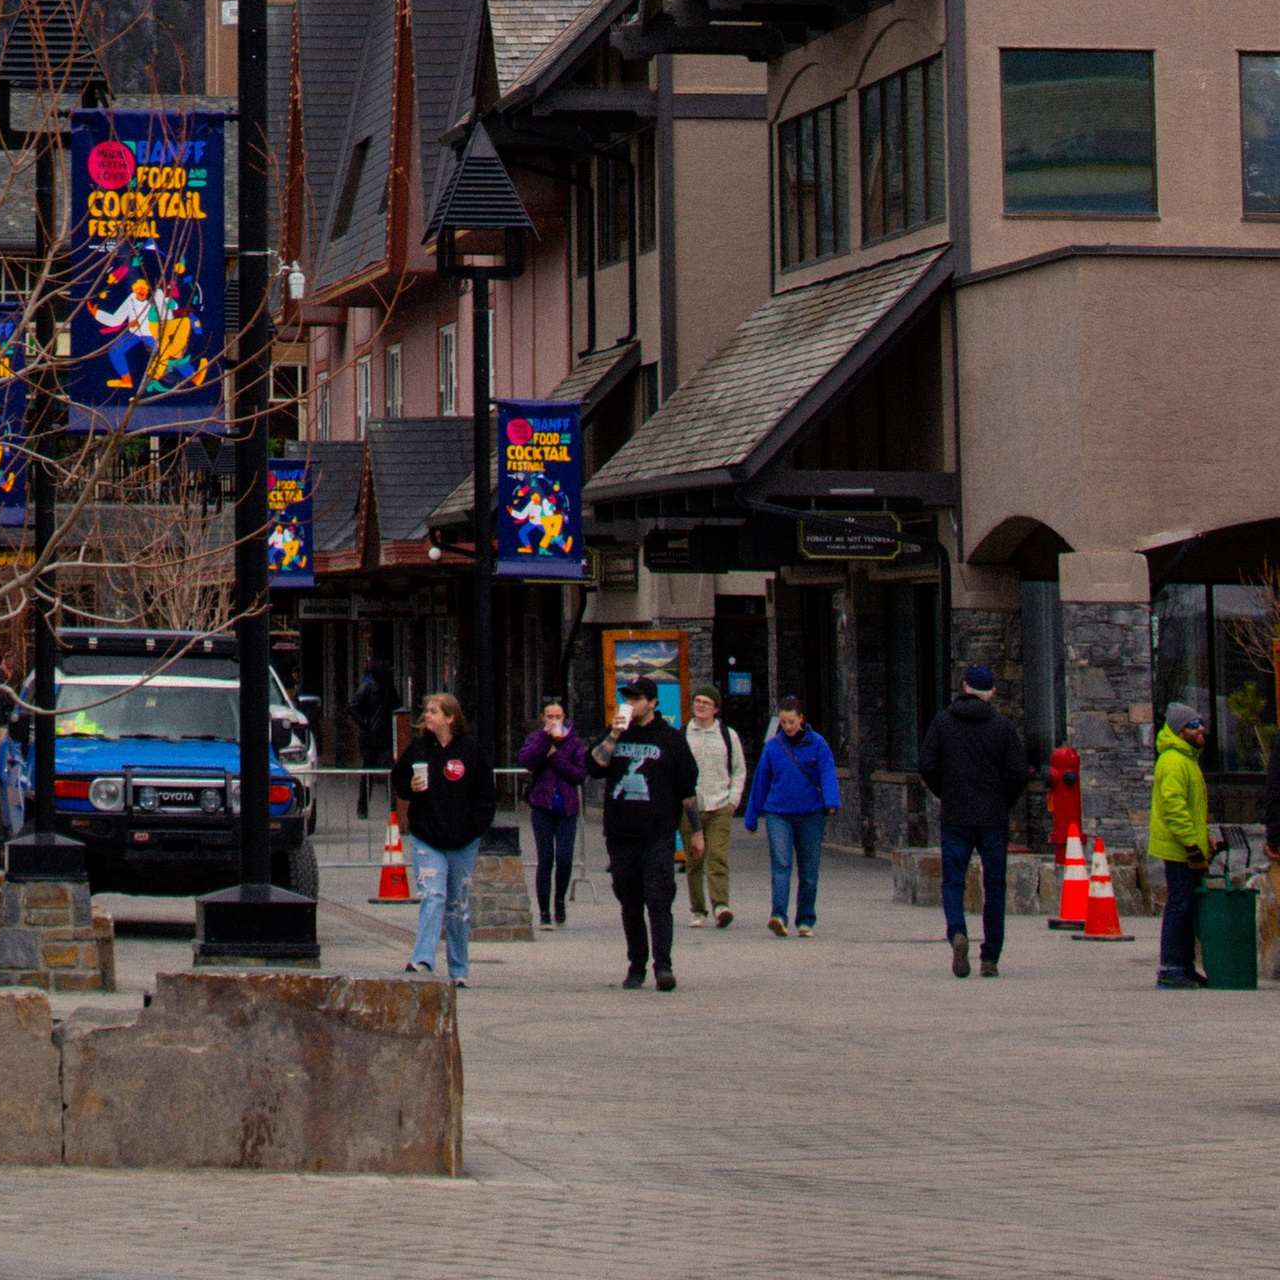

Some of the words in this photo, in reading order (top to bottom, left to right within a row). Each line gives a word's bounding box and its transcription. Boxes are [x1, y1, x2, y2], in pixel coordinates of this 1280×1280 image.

[137, 140, 206, 164] BANFF
[136, 166, 187, 189] FOOD
[188, 168, 207, 179] AND
[533, 418, 570, 431] BANFF
[533, 432, 560, 445] FOOD
